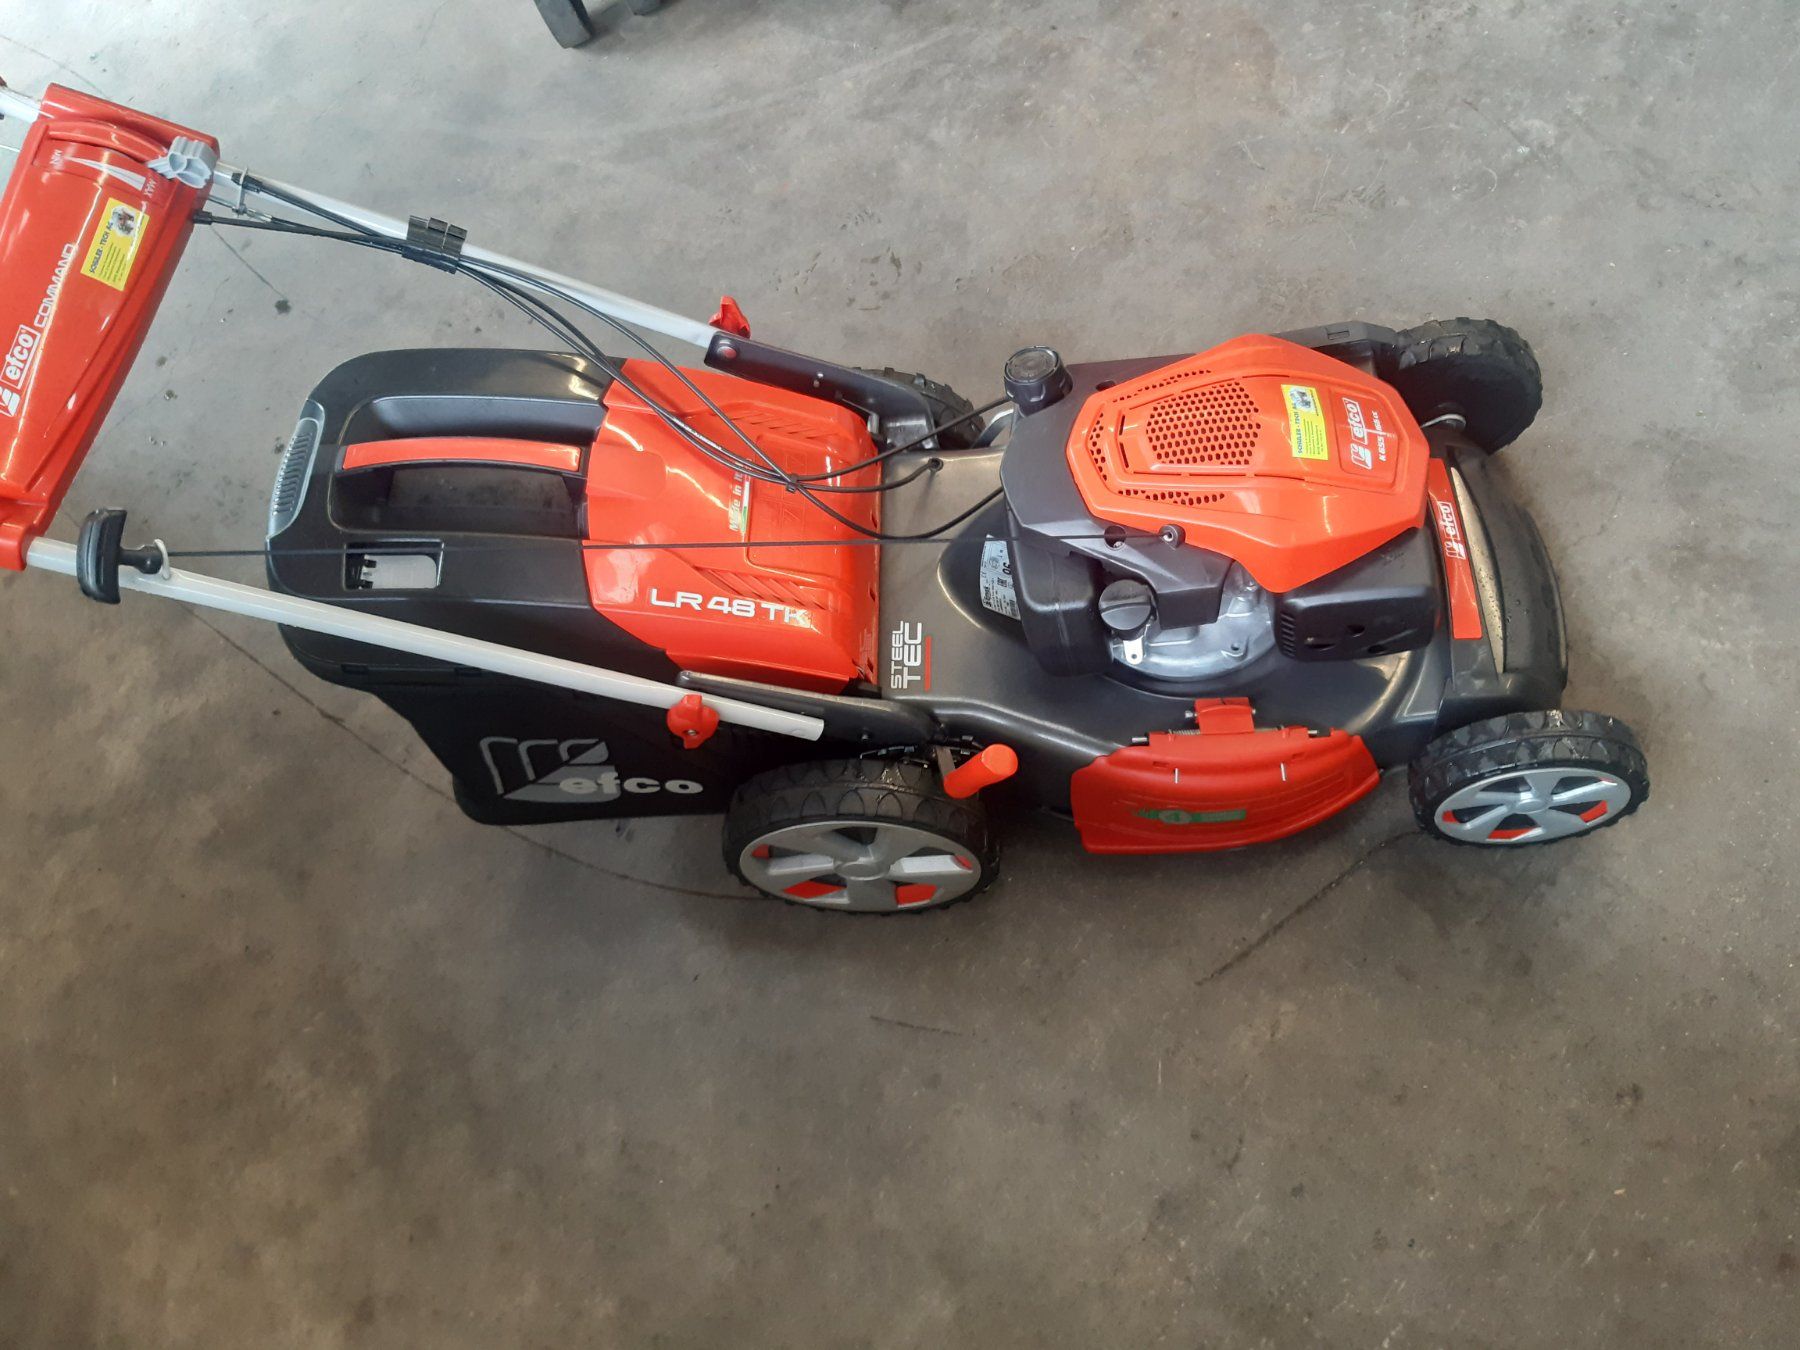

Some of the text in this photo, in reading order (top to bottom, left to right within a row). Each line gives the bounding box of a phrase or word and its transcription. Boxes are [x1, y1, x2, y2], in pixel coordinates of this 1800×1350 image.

[34, 243, 76, 328] COMMAND
[5, 333, 34, 380] efco
[1346, 403, 1364, 438] efco
[732, 484, 742, 496] in
[1439, 504, 1456, 538] efco
[651, 588, 812, 629] LR 48 TK
[890, 620, 904, 690] STEEL
[903, 622, 922, 690] TEC
[559, 770, 704, 795] efco
